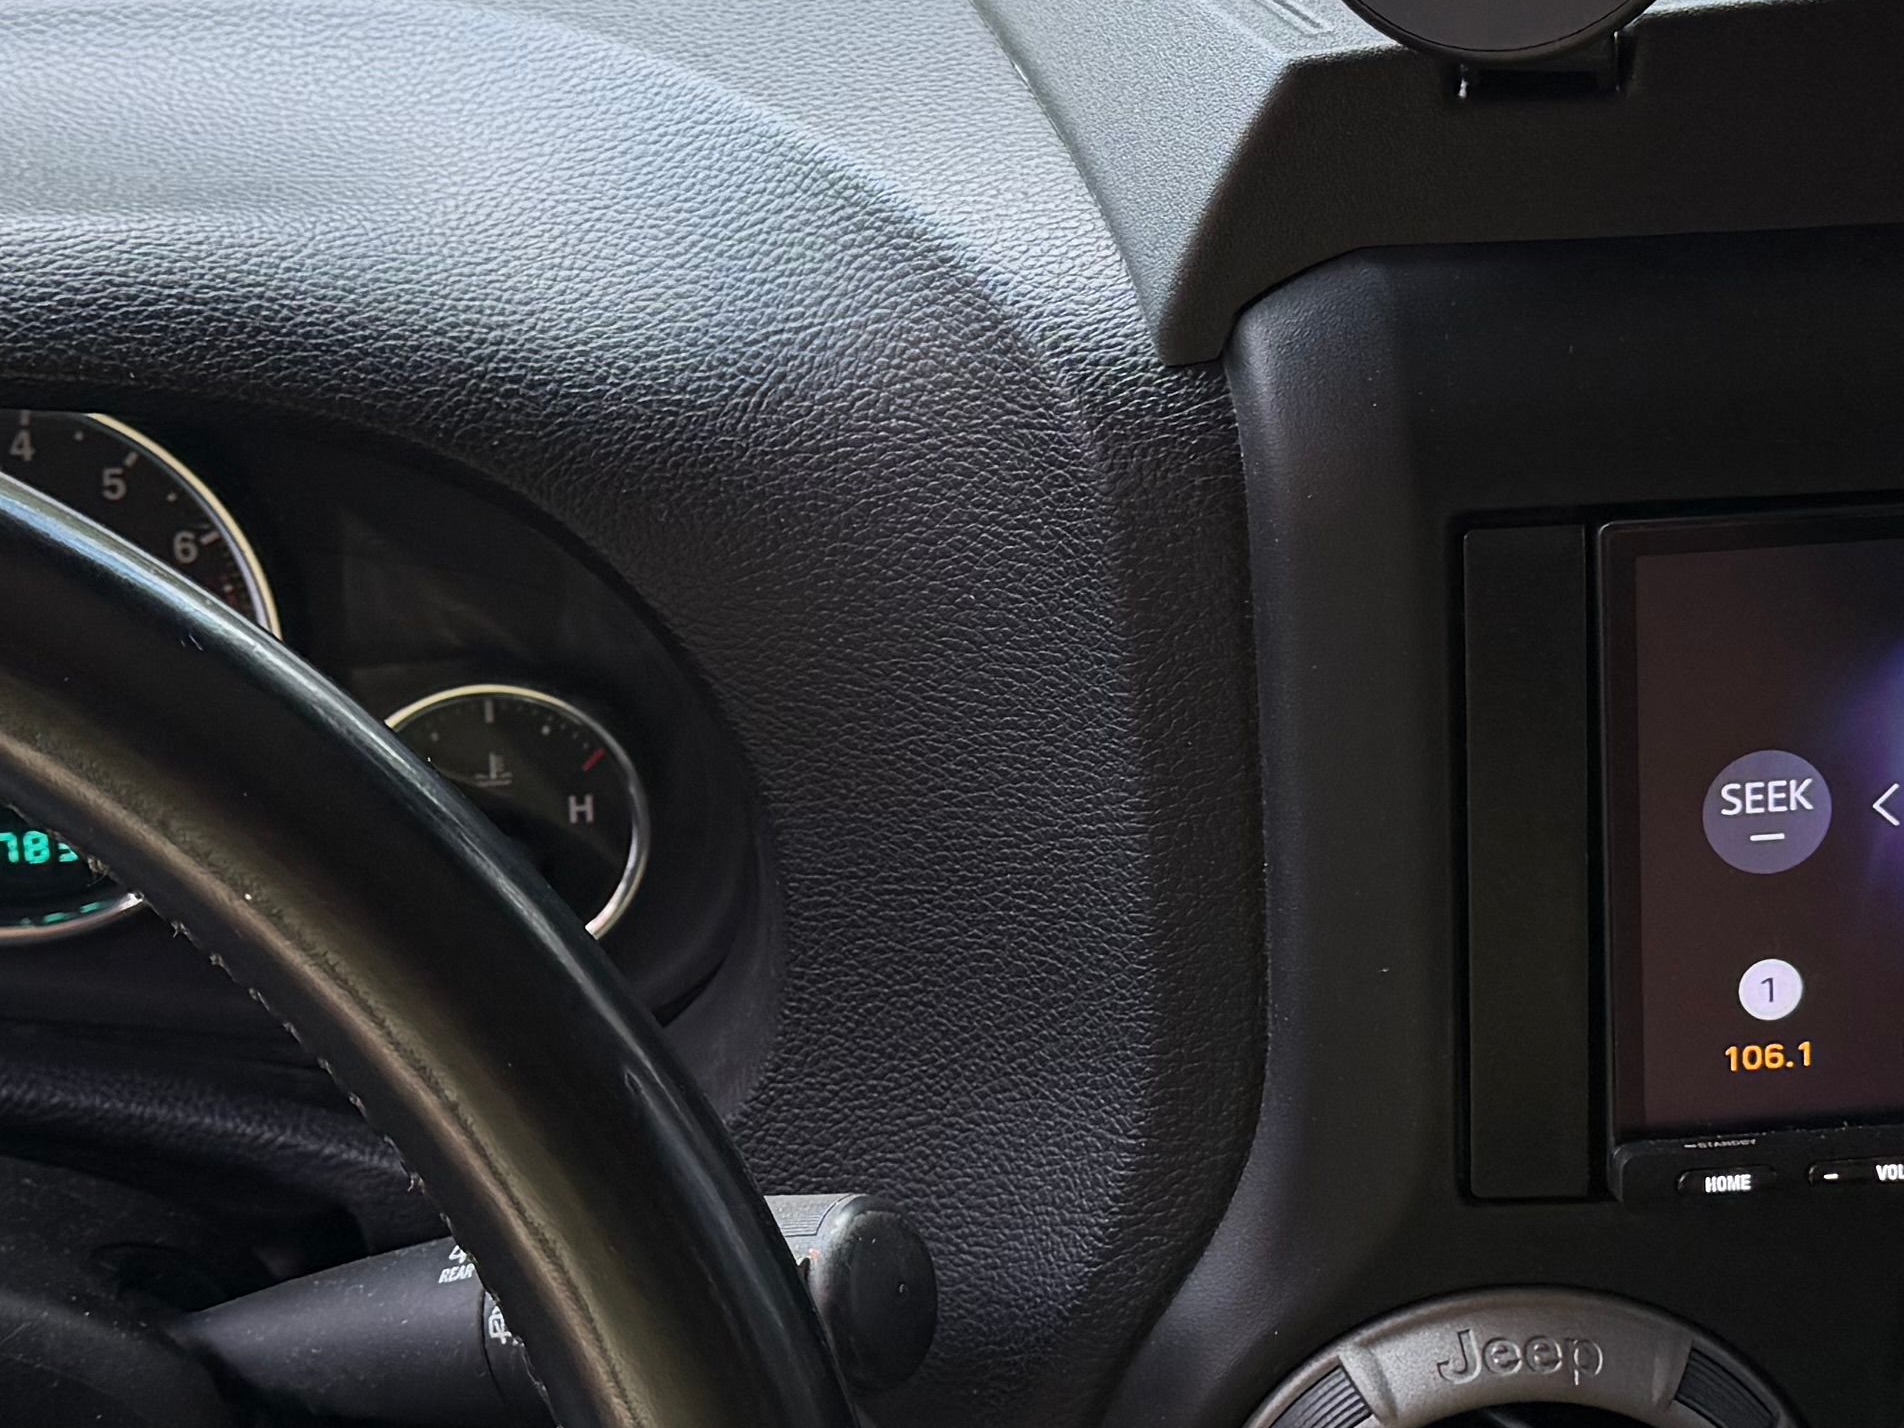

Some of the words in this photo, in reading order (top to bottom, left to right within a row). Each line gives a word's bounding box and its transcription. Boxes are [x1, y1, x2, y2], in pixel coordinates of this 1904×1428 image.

[9, 430, 35, 462] 4
[102, 468, 127, 500] 5
[173, 531, 196, 563] 6
[569, 795, 594, 824] H
[1721, 778, 1814, 815] SEEK
[1760, 976, 1775, 1003] 1
[1725, 1041, 1814, 1072] 106.1
[1705, 1174, 1752, 1193] HOME
[438, 1263, 475, 1284] REAR
[1436, 1327, 1604, 1387] Jeep
